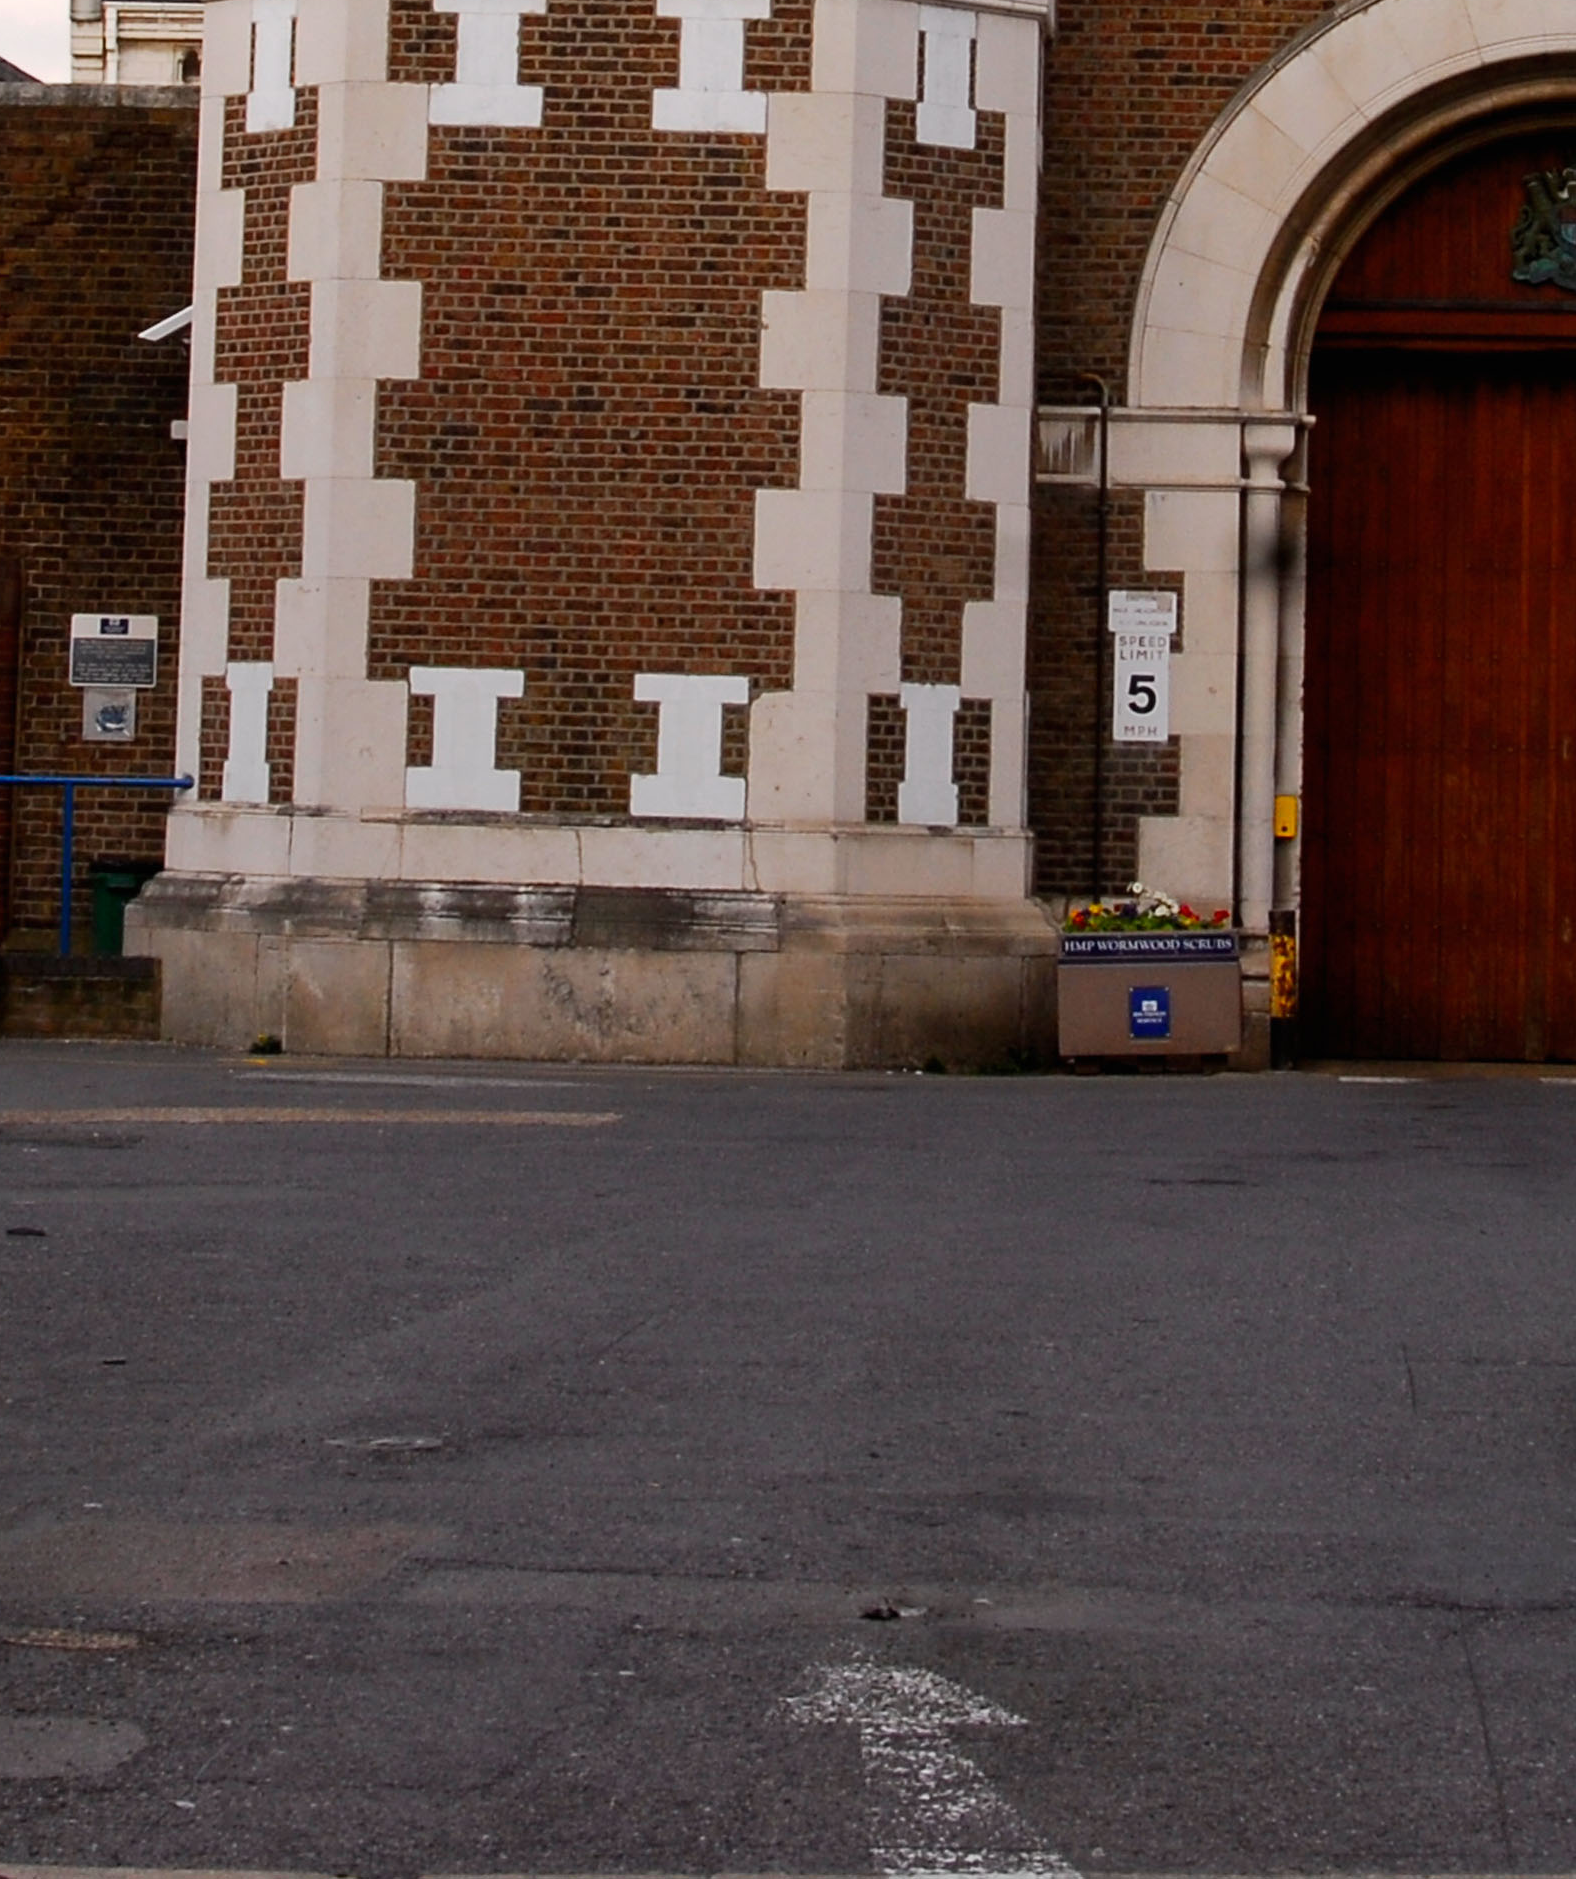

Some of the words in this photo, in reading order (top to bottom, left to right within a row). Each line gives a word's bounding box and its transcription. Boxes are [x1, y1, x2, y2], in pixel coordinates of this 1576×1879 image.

[1118, 636, 1167, 648] SPEED
[1119, 650, 1165, 661] LIMIT
[1128, 674, 1157, 714] 5
[1123, 726, 1158, 736] MPH
[1064, 940, 1095, 953] HMP
[1096, 939, 1181, 952] WORMWOOD
[1182, 938, 1233, 950] SCRUBS
